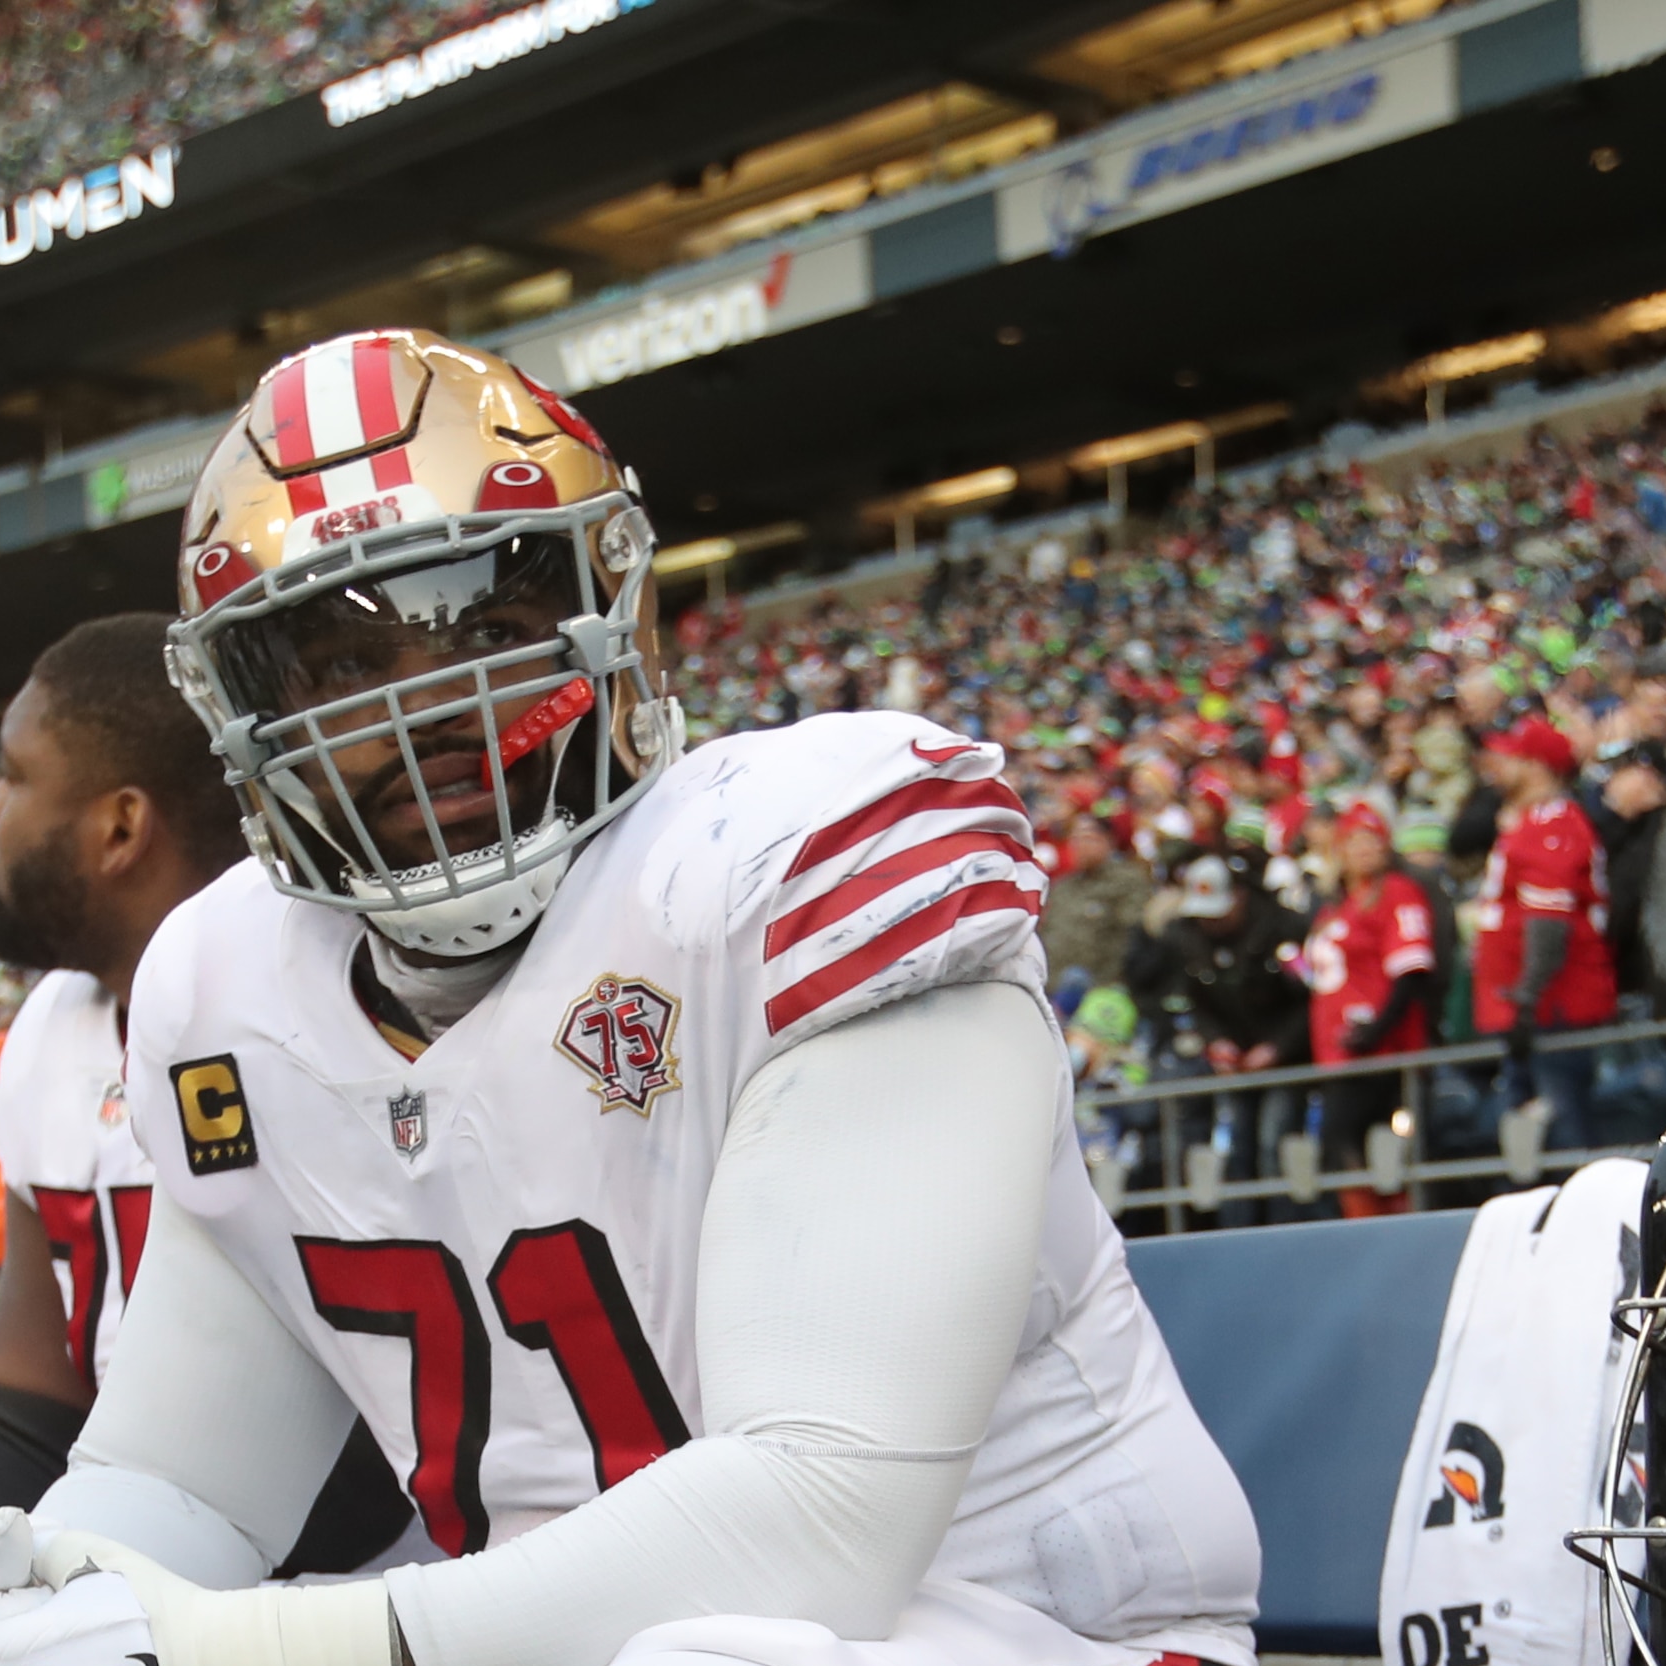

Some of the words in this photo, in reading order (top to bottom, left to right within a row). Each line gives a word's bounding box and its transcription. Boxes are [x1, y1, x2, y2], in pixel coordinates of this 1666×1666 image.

[557, 280, 767, 391] verizon
[579, 996, 664, 1078] 75
[176, 1062, 243, 1143] C
[291, 1218, 693, 1558] 71
